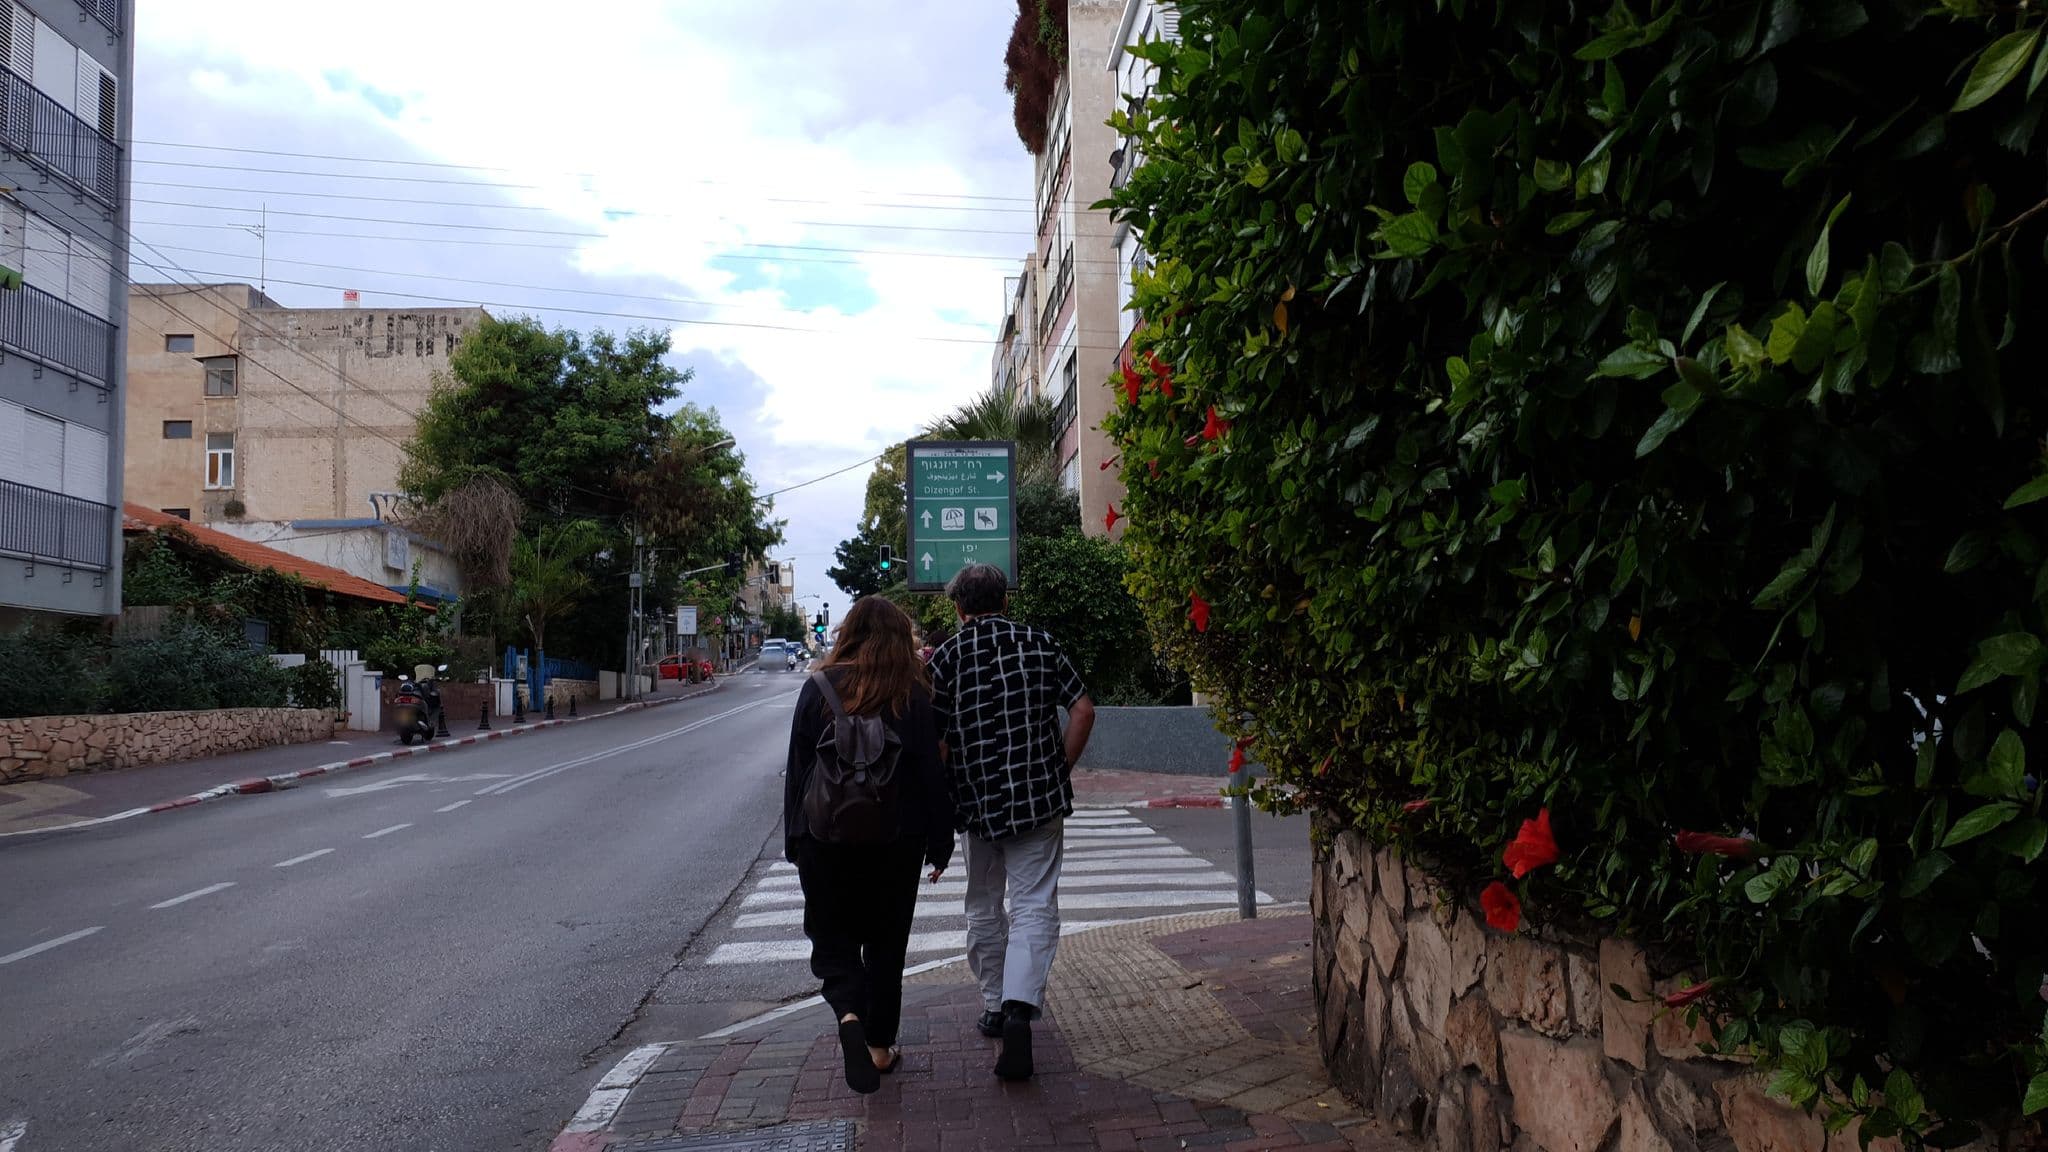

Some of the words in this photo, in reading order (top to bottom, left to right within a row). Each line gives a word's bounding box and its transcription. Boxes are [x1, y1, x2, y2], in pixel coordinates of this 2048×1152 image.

[921, 460, 958, 471] דיזנגוף
[924, 485, 964, 496] Dizengof
[962, 544, 978, 552] יפו
